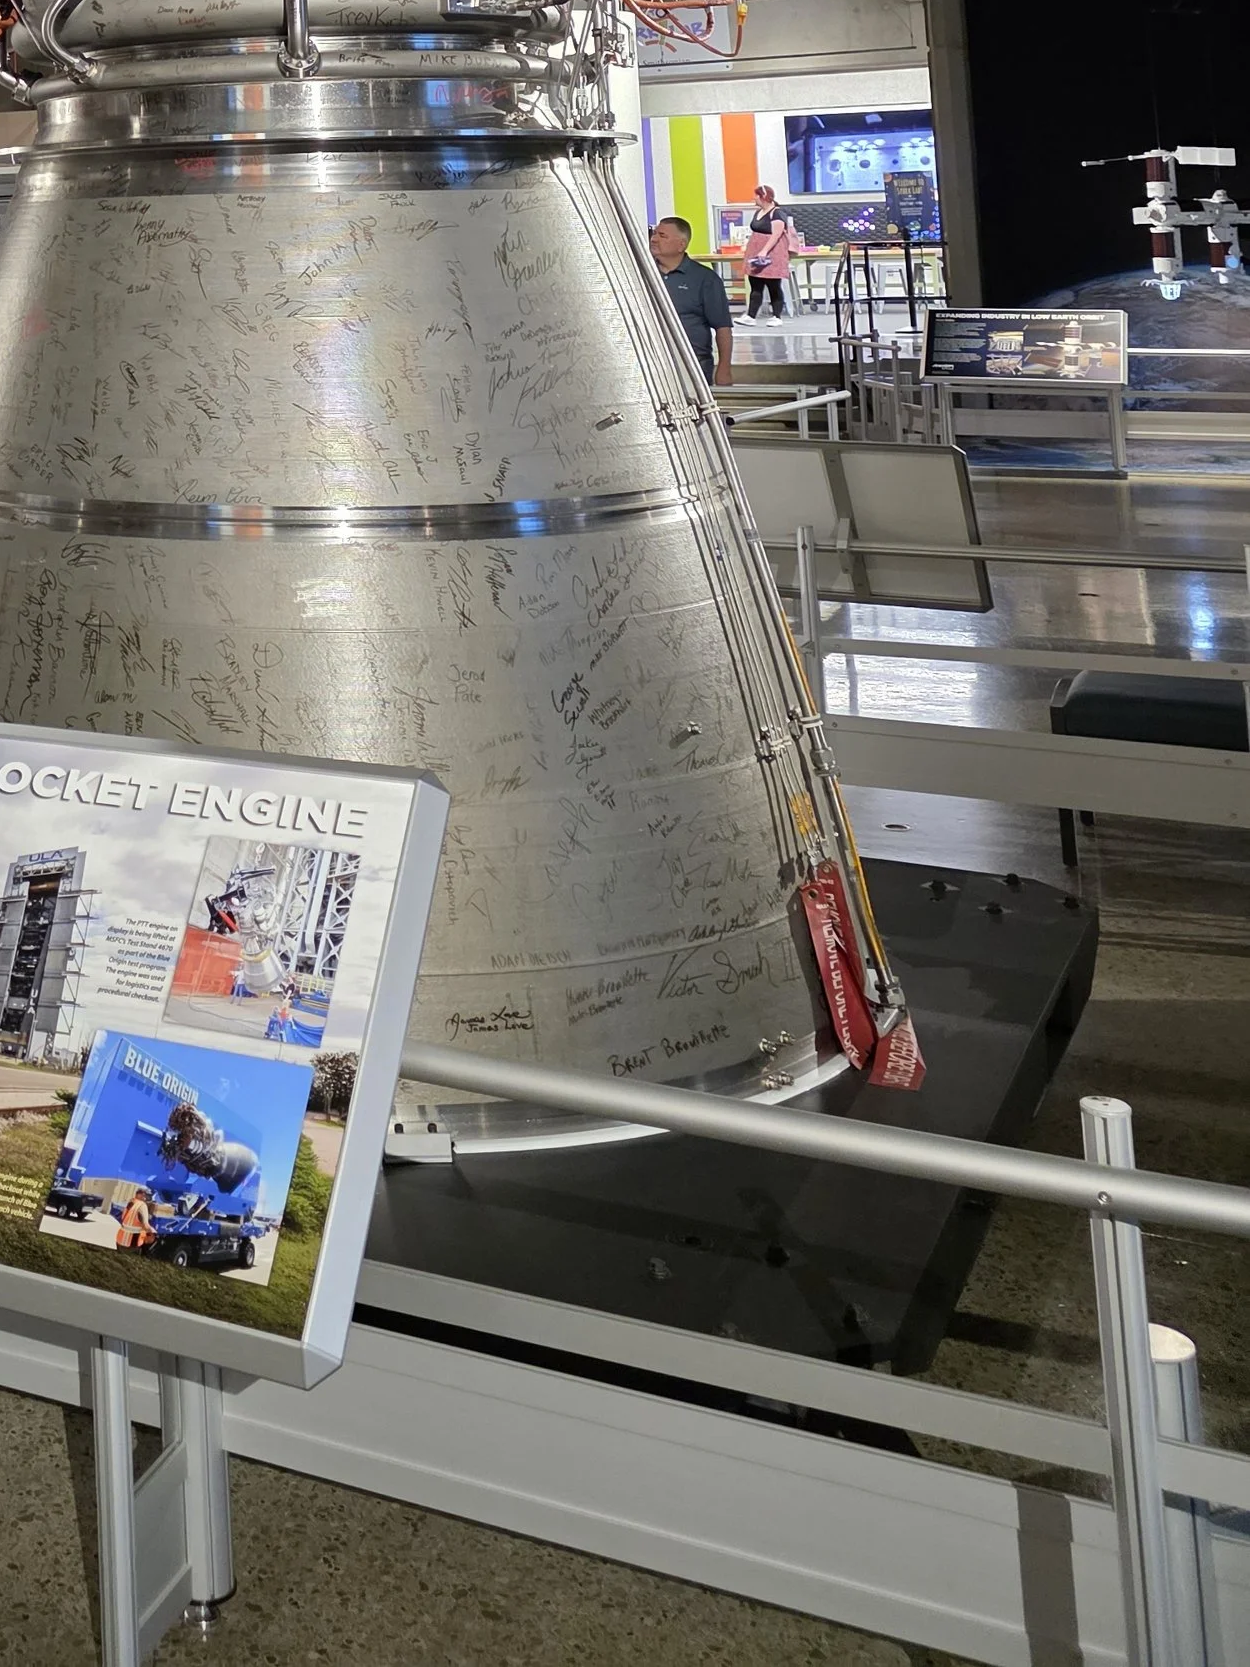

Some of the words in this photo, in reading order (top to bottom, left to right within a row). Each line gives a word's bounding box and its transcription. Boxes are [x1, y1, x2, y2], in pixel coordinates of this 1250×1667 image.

[418, 53, 457, 66] MIKE
[454, 685, 482, 704] Pate
[169, 781, 370, 838] ENGINE
[28, 849, 63, 863] ULA
[125, 918, 137, 926] The
[136, 920, 149, 928] PTT
[149, 923, 170, 932] engine
[107, 926, 128, 936] display
[134, 930, 151, 939] being
[152, 932, 168, 941] lifted
[126, 938, 139, 946] Test
[139, 940, 158, 950] Stand
[158, 944, 173, 952] 4670
[108, 956, 127, 966] Origin
[127, 959, 139, 967] test
[124, 949, 138, 958] part
[145, 952, 156, 960] the
[156, 954, 170, 962] Blue
[106, 966, 116, 974] The
[117, 969, 138, 978] engine
[150, 973, 166, 982] used
[115, 978, 125, 986] for
[124, 979, 150, 990] logistics
[150, 984, 164, 992] and
[97, 986, 131, 997] procedural
[131, 992, 160, 1003] checkout.
[124, 1044, 161, 1084] BLUE
[162, 1073, 199, 1107] ORIGIN
[17, 1176, 39, 1188] during
[23, 1188, 41, 1199] while
[22, 1199, 37, 1209] Blue
